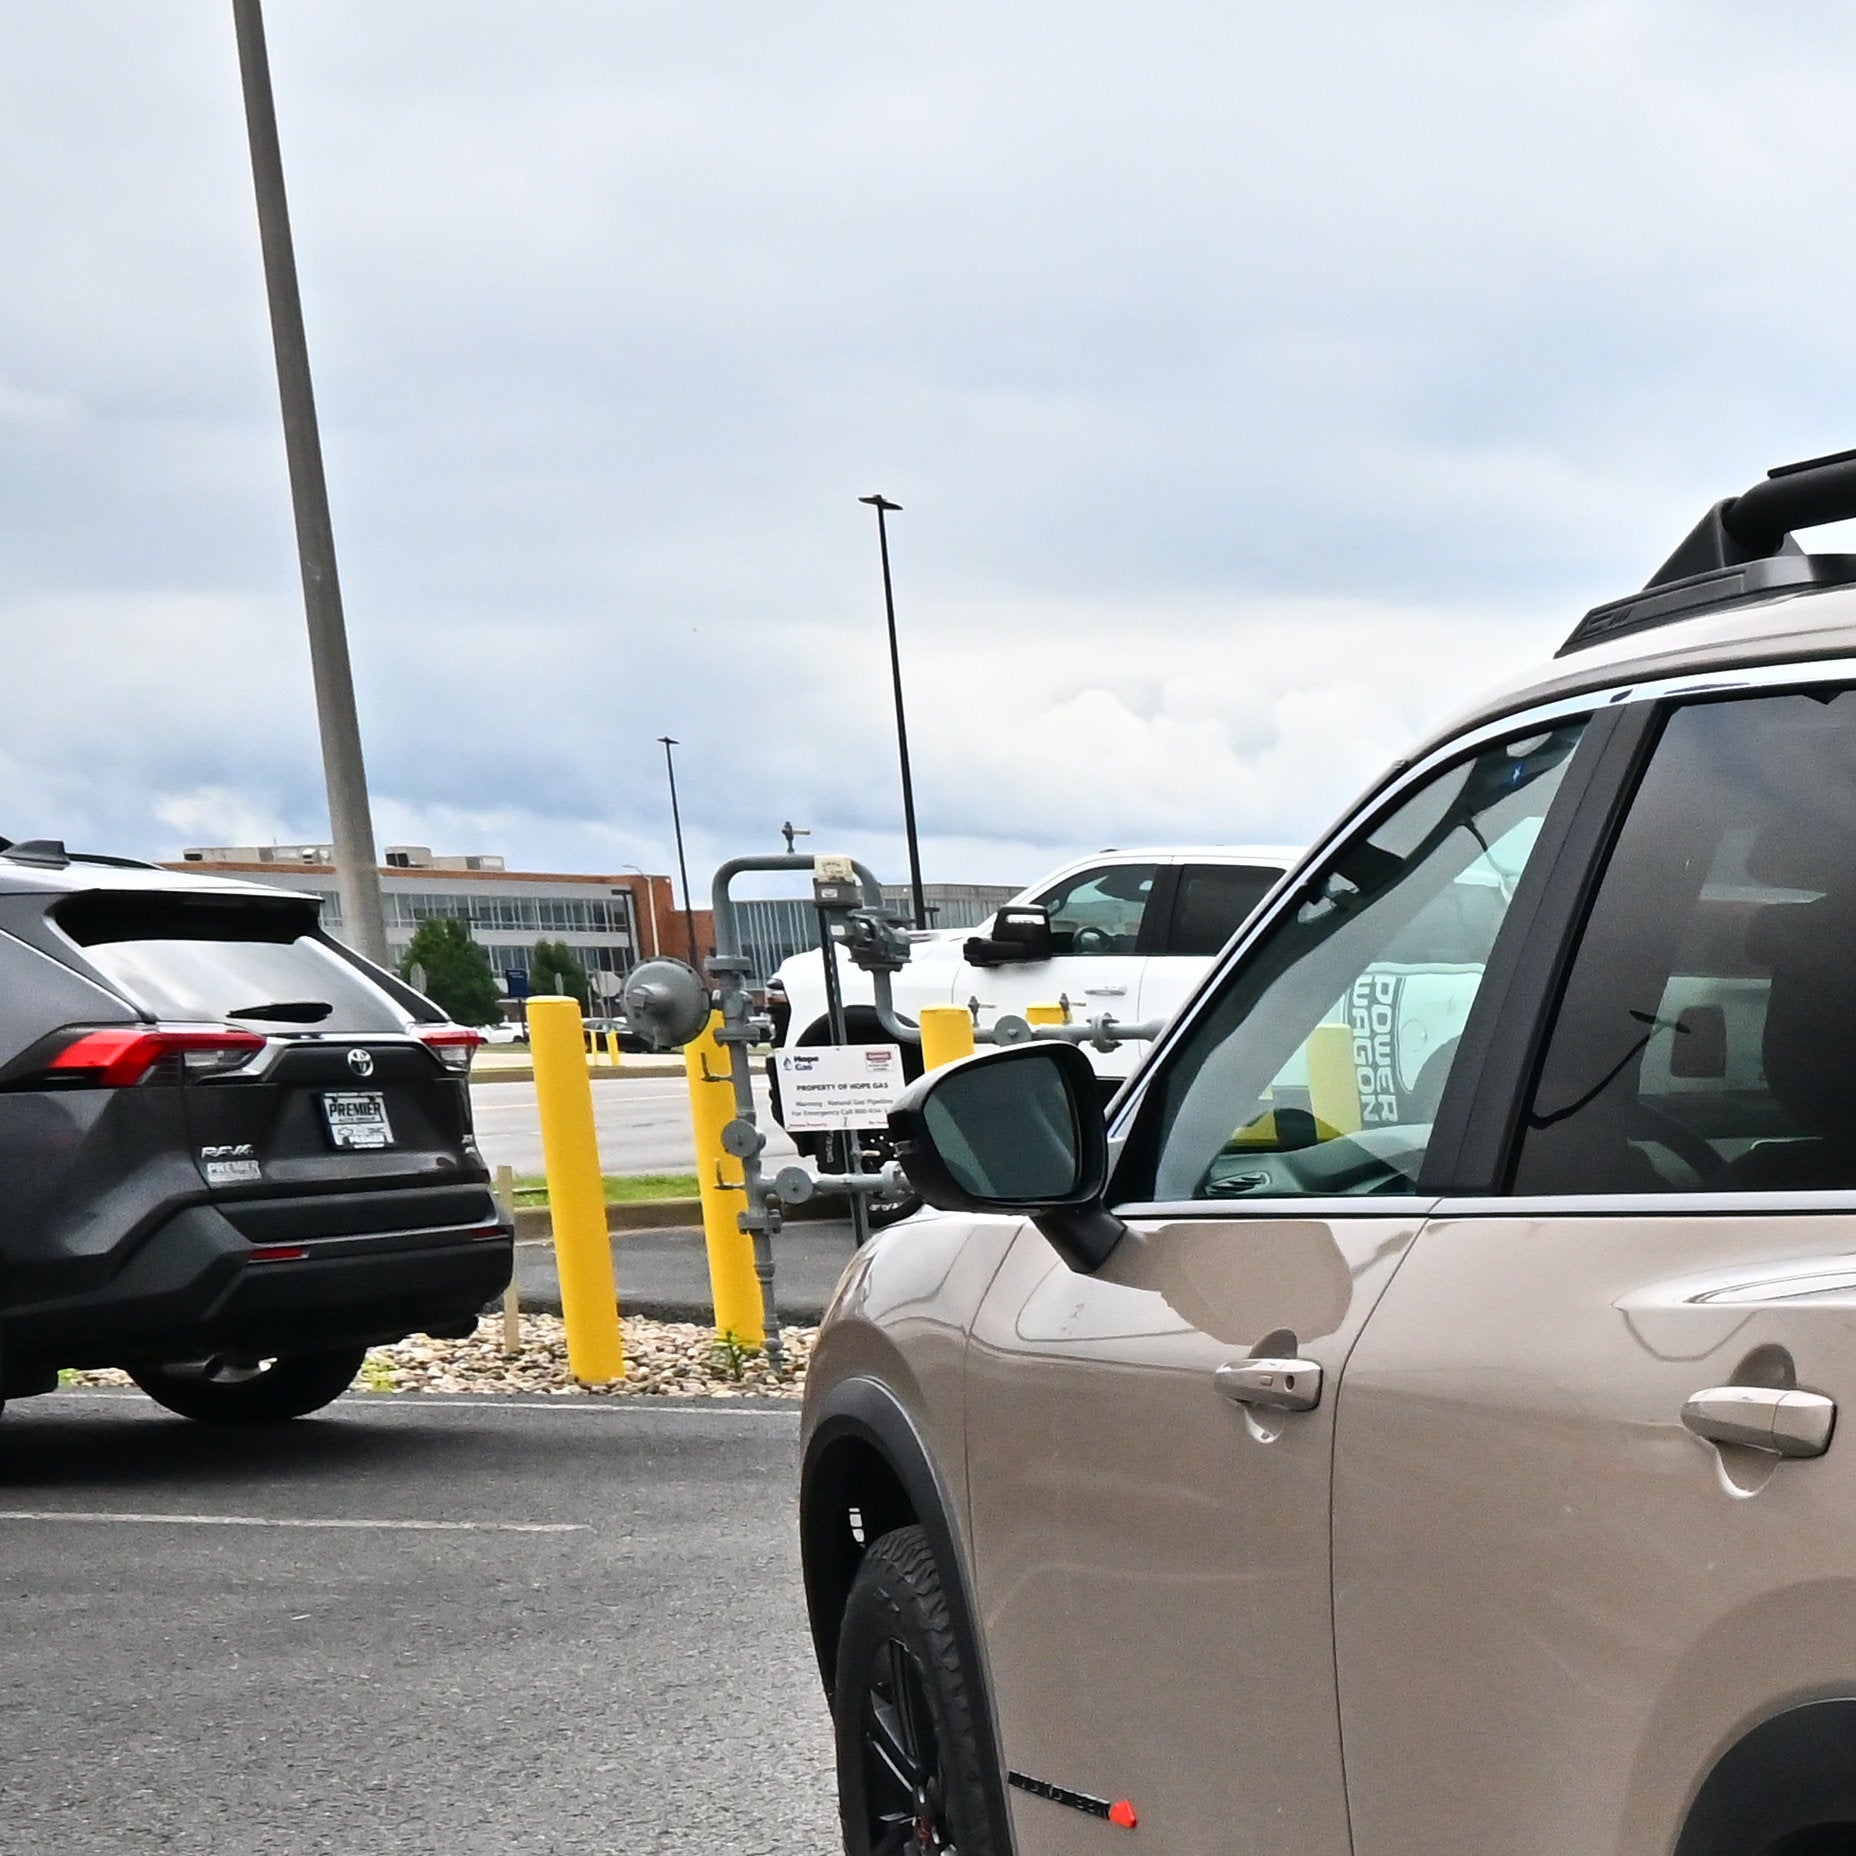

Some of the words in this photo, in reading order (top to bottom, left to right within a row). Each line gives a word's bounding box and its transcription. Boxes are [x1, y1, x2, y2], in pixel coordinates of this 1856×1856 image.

[796, 1084, 835, 1092] PROPERTY
[1352, 974, 1380, 1122] WAGON
[1371, 974, 1399, 1122] POWER
[329, 1102, 382, 1118] PREMIER
